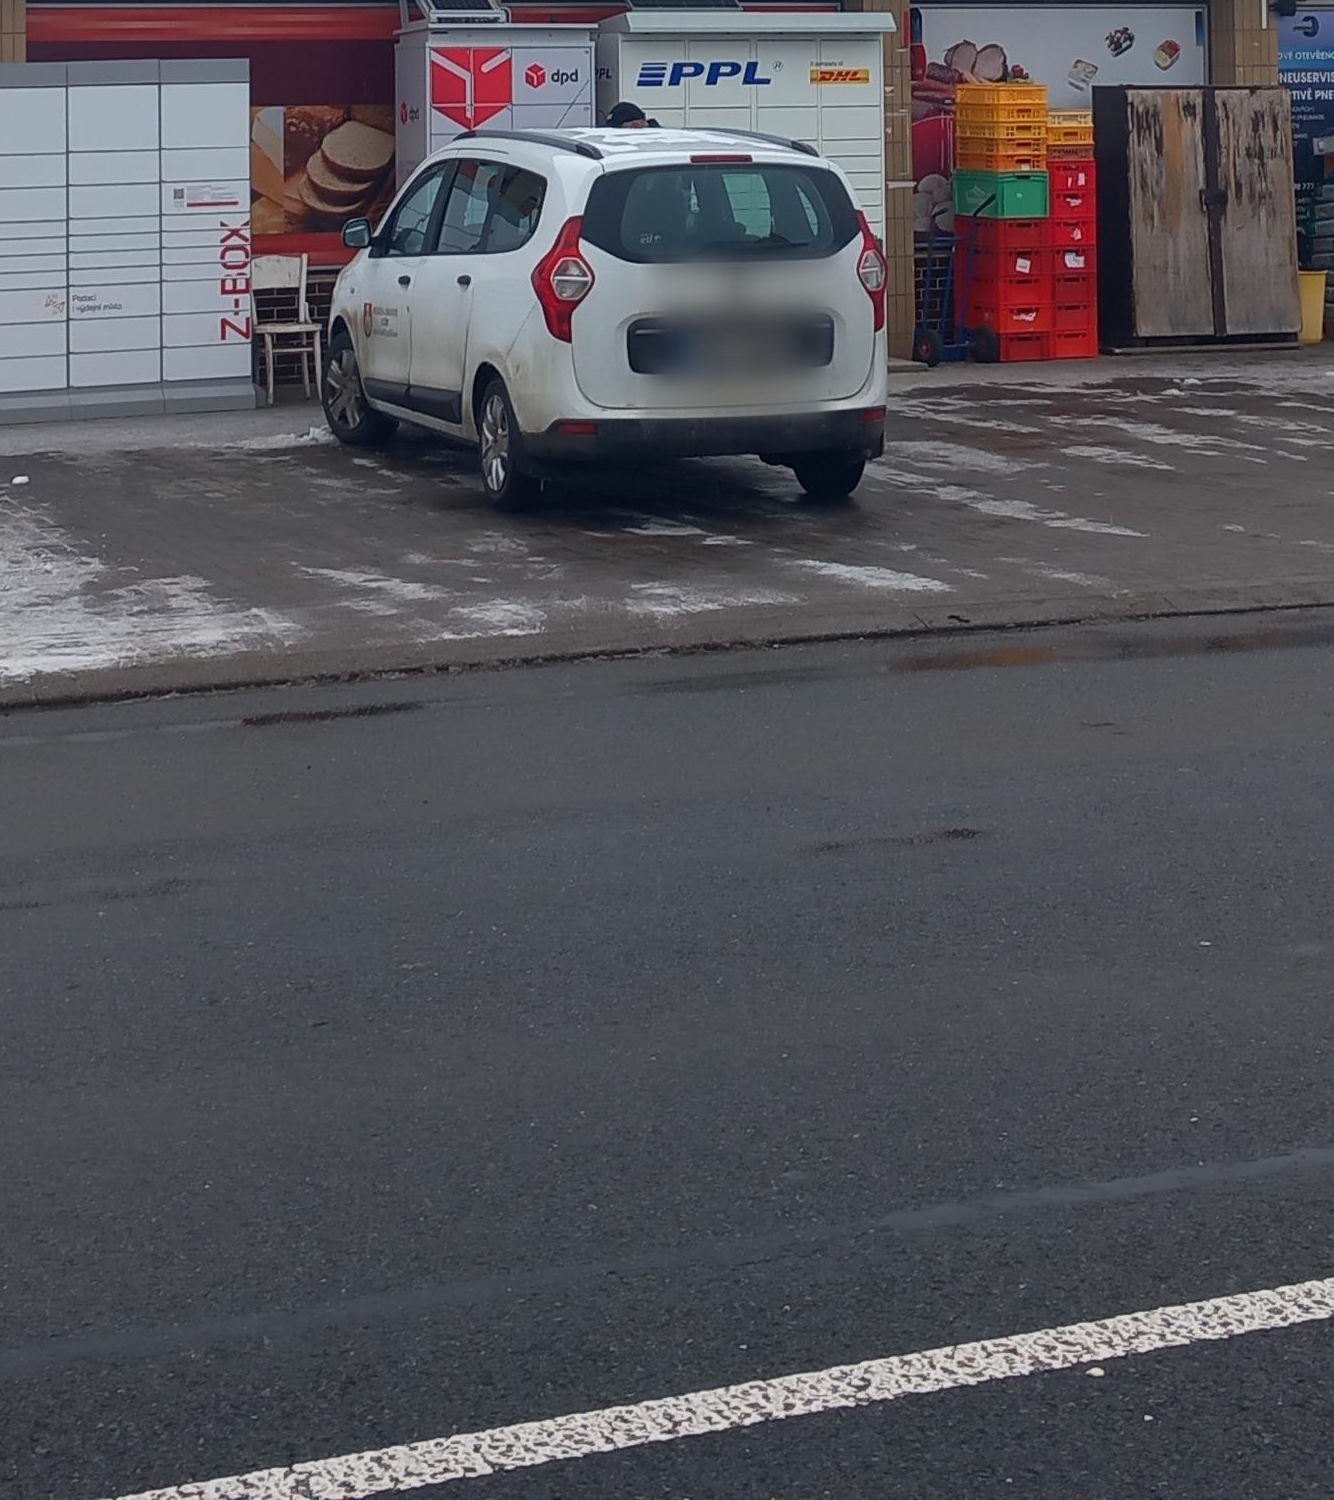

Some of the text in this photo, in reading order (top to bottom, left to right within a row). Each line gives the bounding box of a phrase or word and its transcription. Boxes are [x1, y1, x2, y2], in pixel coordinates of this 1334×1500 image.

[551, 68, 579, 85] dpd
[668, 61, 771, 86] PPL
[819, 71, 860, 82] DHL
[220, 219, 251, 341] Z-BOX
